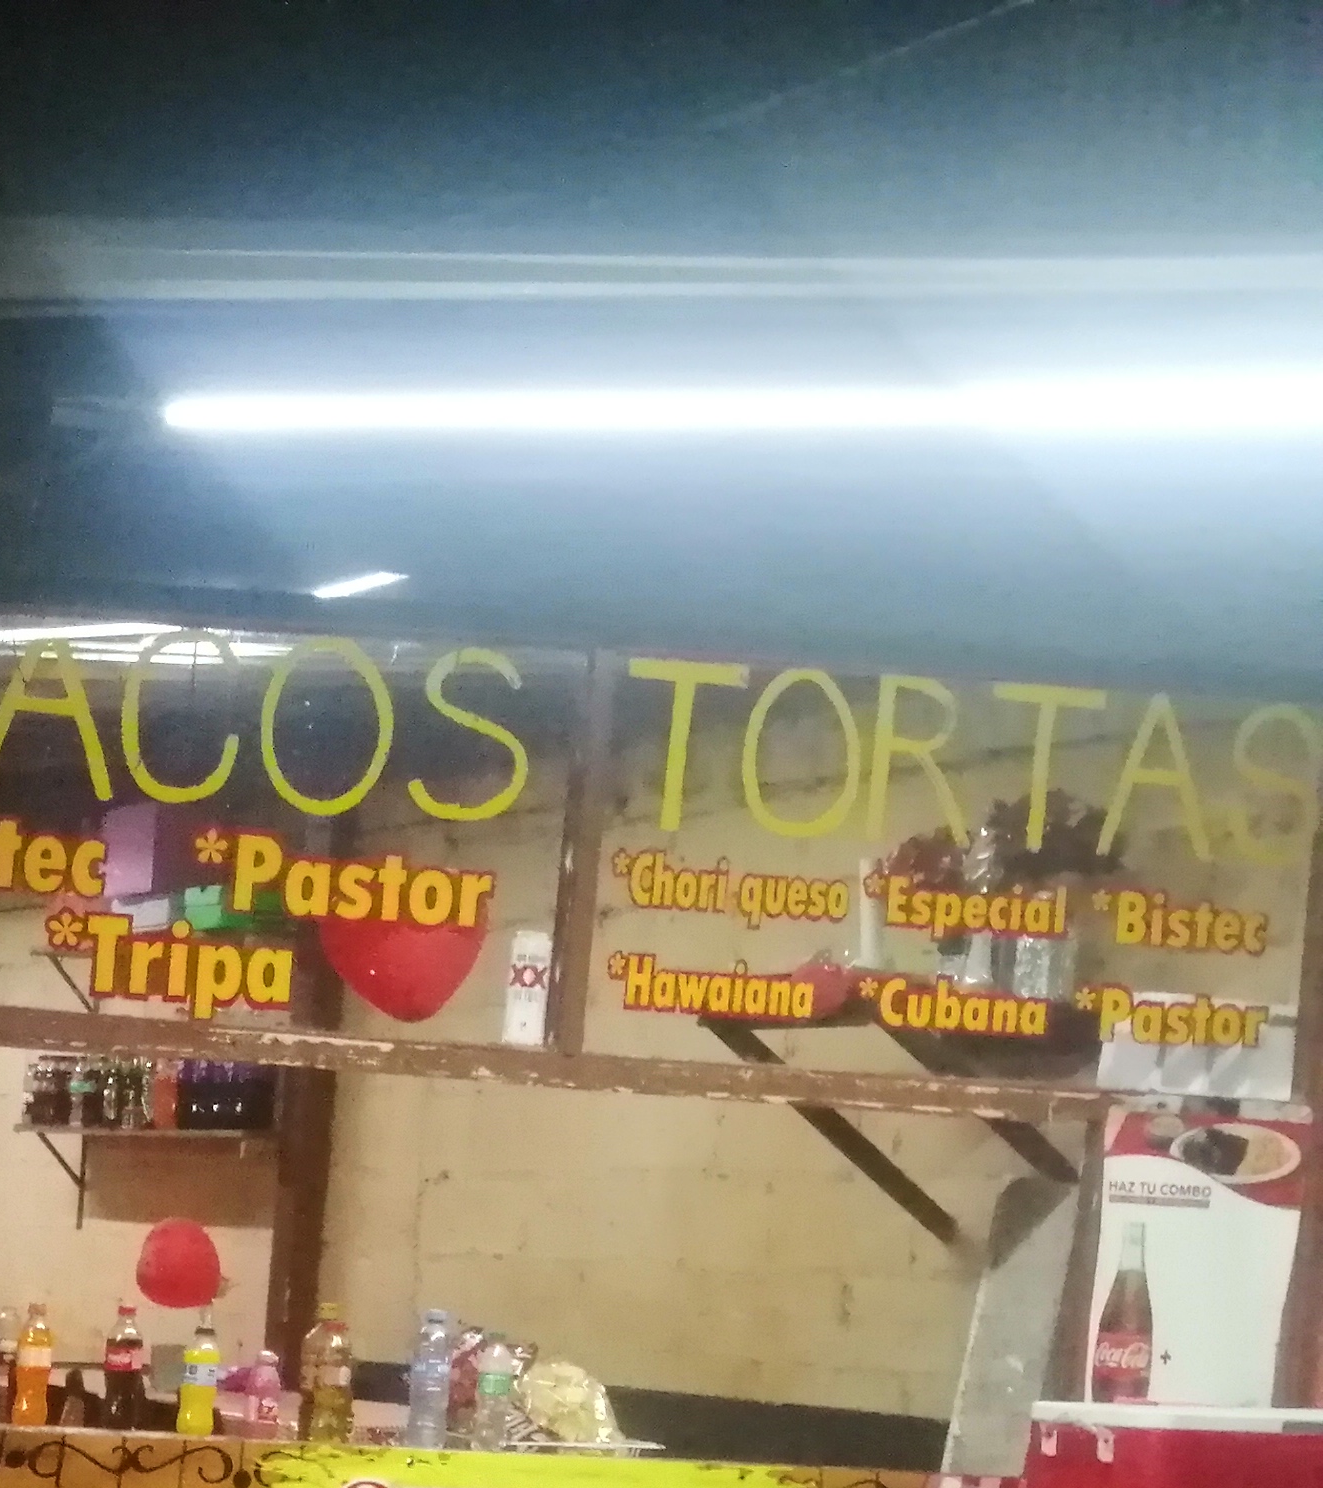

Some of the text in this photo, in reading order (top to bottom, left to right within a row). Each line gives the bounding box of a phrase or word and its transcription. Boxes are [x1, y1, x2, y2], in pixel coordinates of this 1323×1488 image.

[628, 656, 1323, 864] TORTAS
[232, 834, 496, 928] Pastor
[885, 877, 1066, 937] Especial
[1114, 890, 1269, 956] Bistec
[85, 914, 295, 1018] Tripa
[623, 955, 1269, 1047] Hawaiana Cubana Pastor
[1109, 1181, 1212, 1196] HAZ TU COMBO
